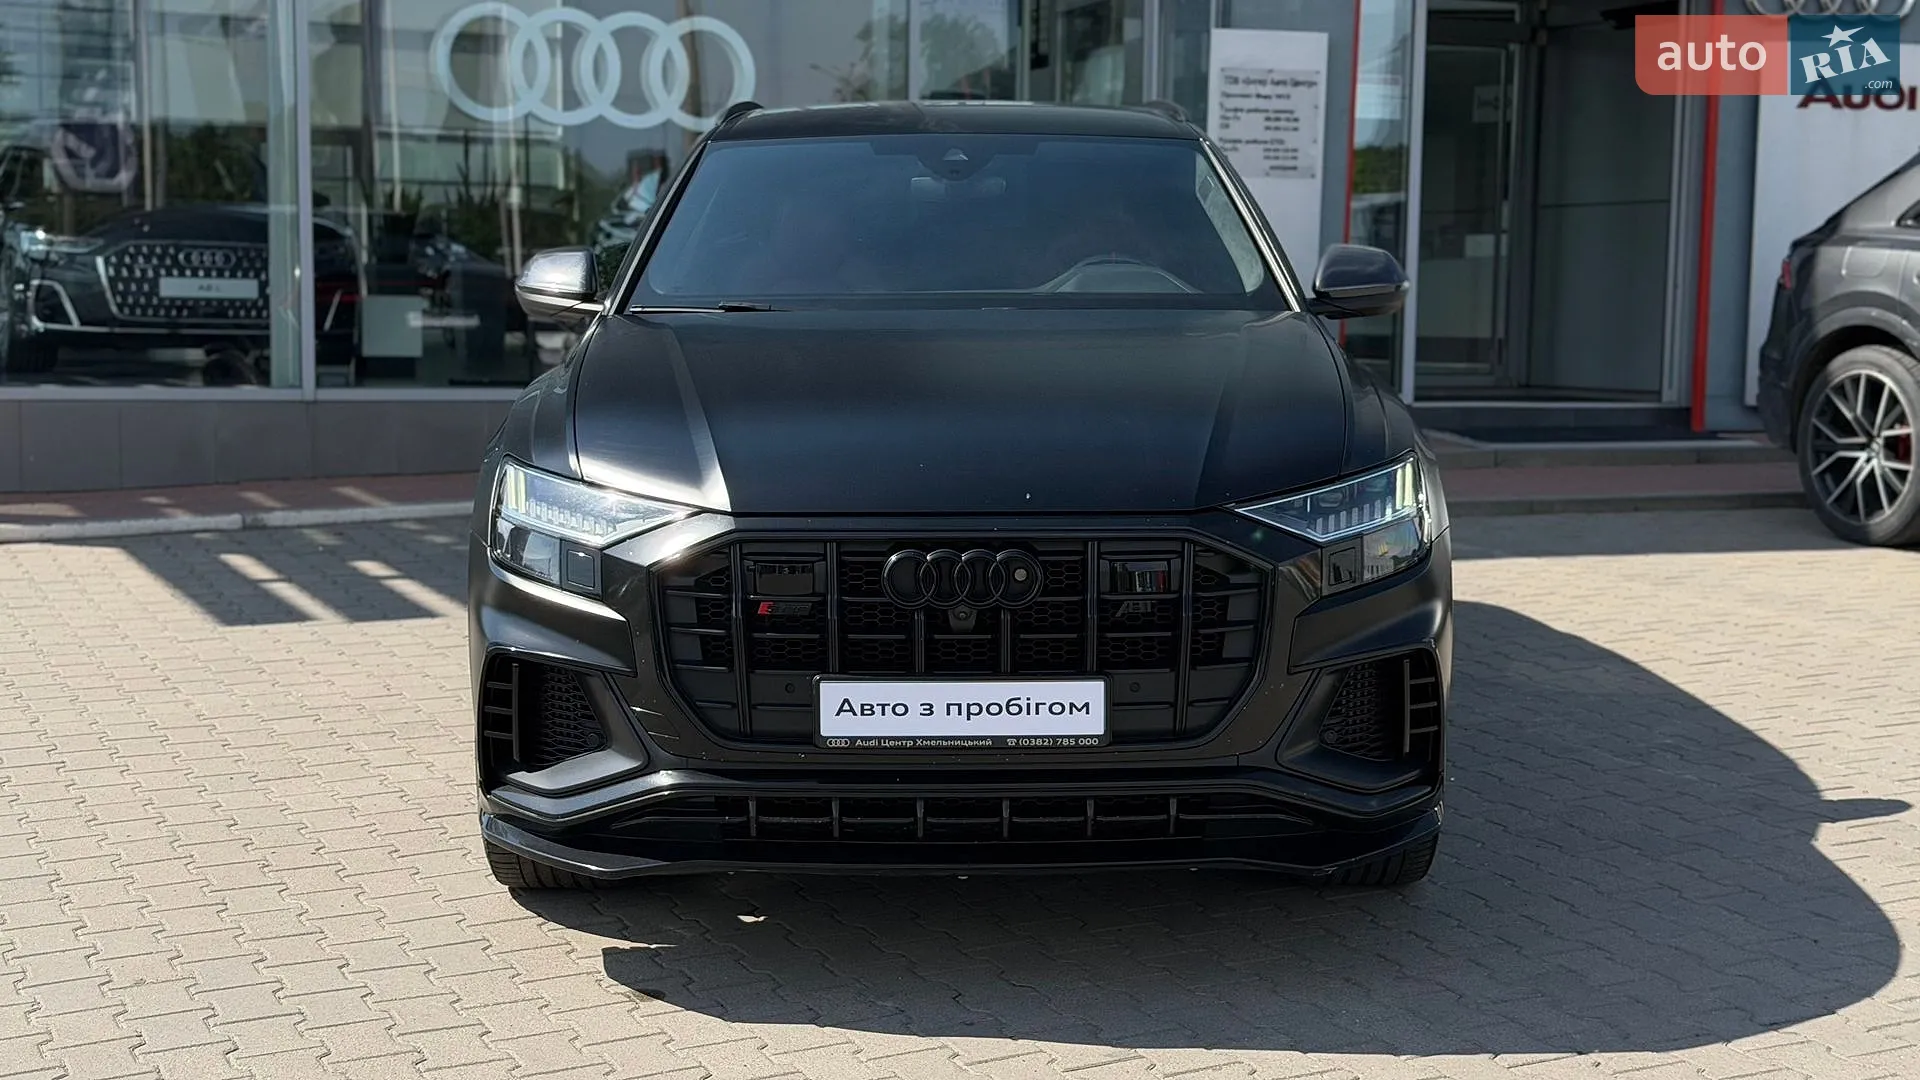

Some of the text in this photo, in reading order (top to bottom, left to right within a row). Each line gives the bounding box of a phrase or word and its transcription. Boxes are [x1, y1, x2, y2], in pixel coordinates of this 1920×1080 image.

[835, 697, 1090, 721] Авто з пробігом
[855, 738, 993, 748] Audi Центр Хмельницький
[1019, 738, 1099, 746] (0382) 785 000
